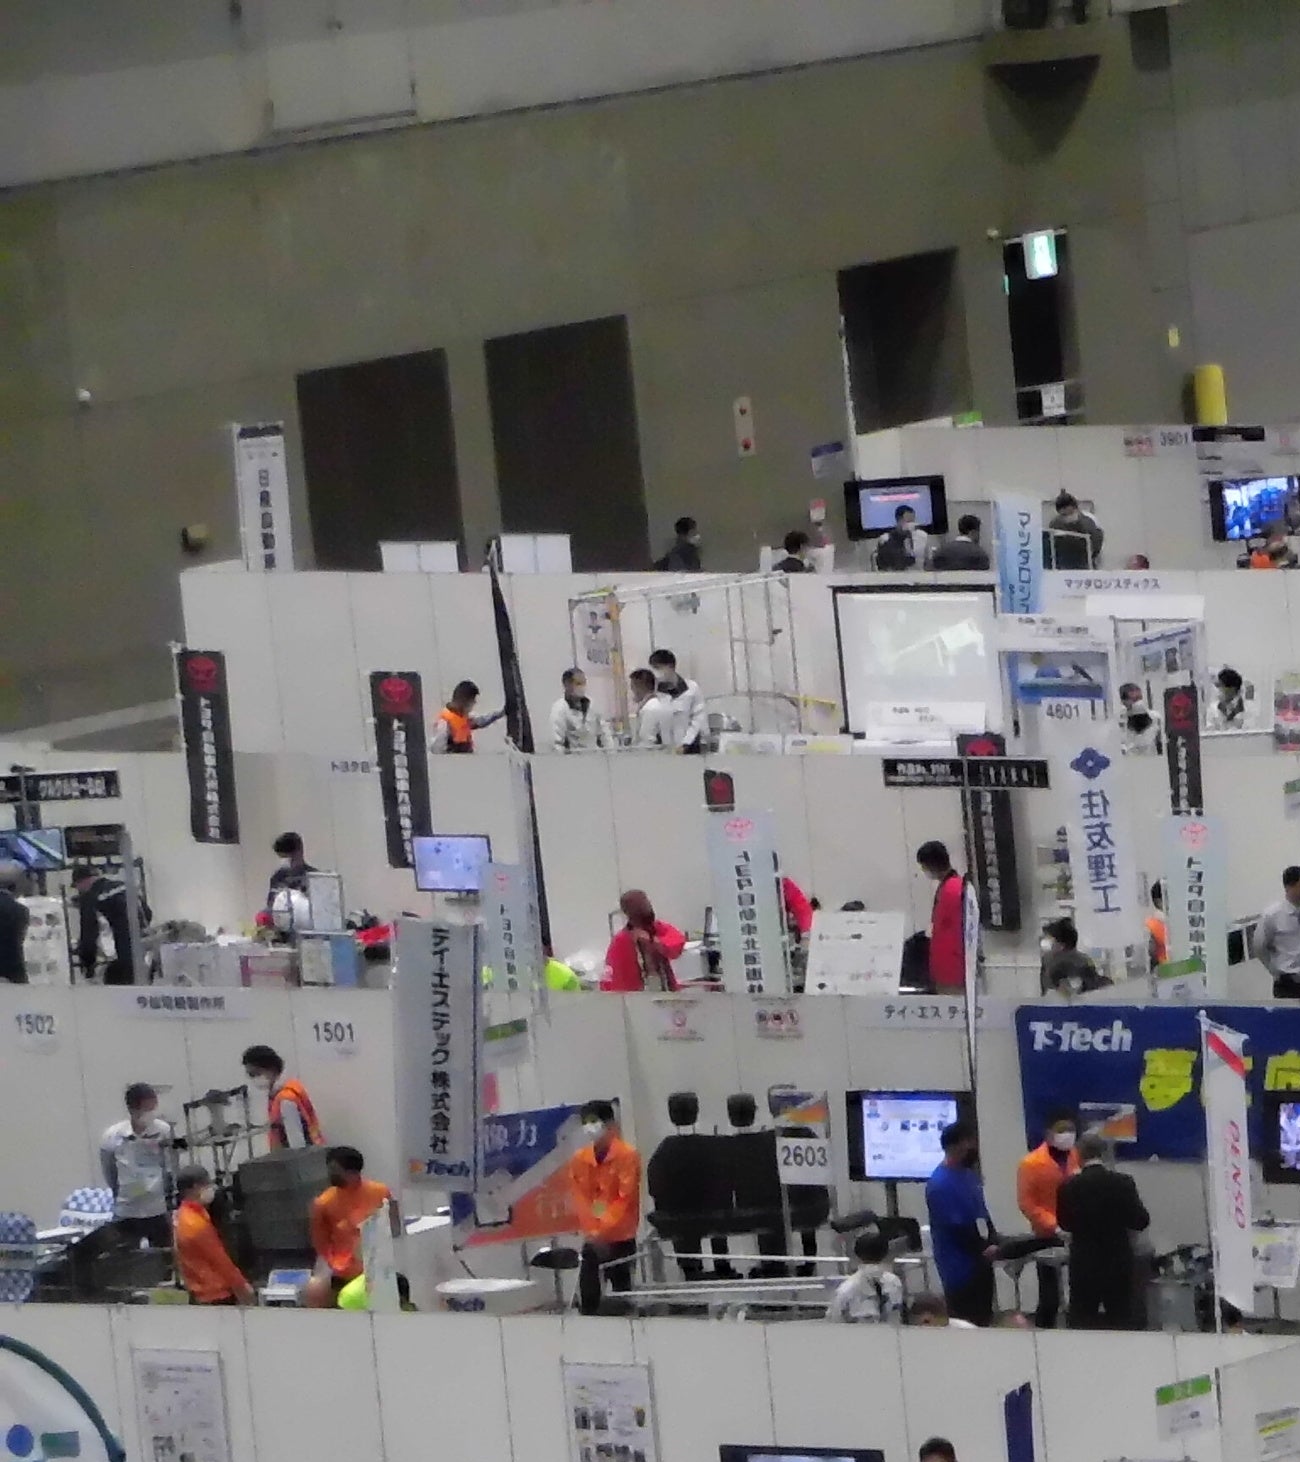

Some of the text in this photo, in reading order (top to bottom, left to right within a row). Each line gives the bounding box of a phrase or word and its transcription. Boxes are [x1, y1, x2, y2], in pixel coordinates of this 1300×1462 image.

[15, 1016, 56, 1036] 1502
[312, 1023, 356, 1043] 1501
[781, 1144, 828, 1168] 2603
